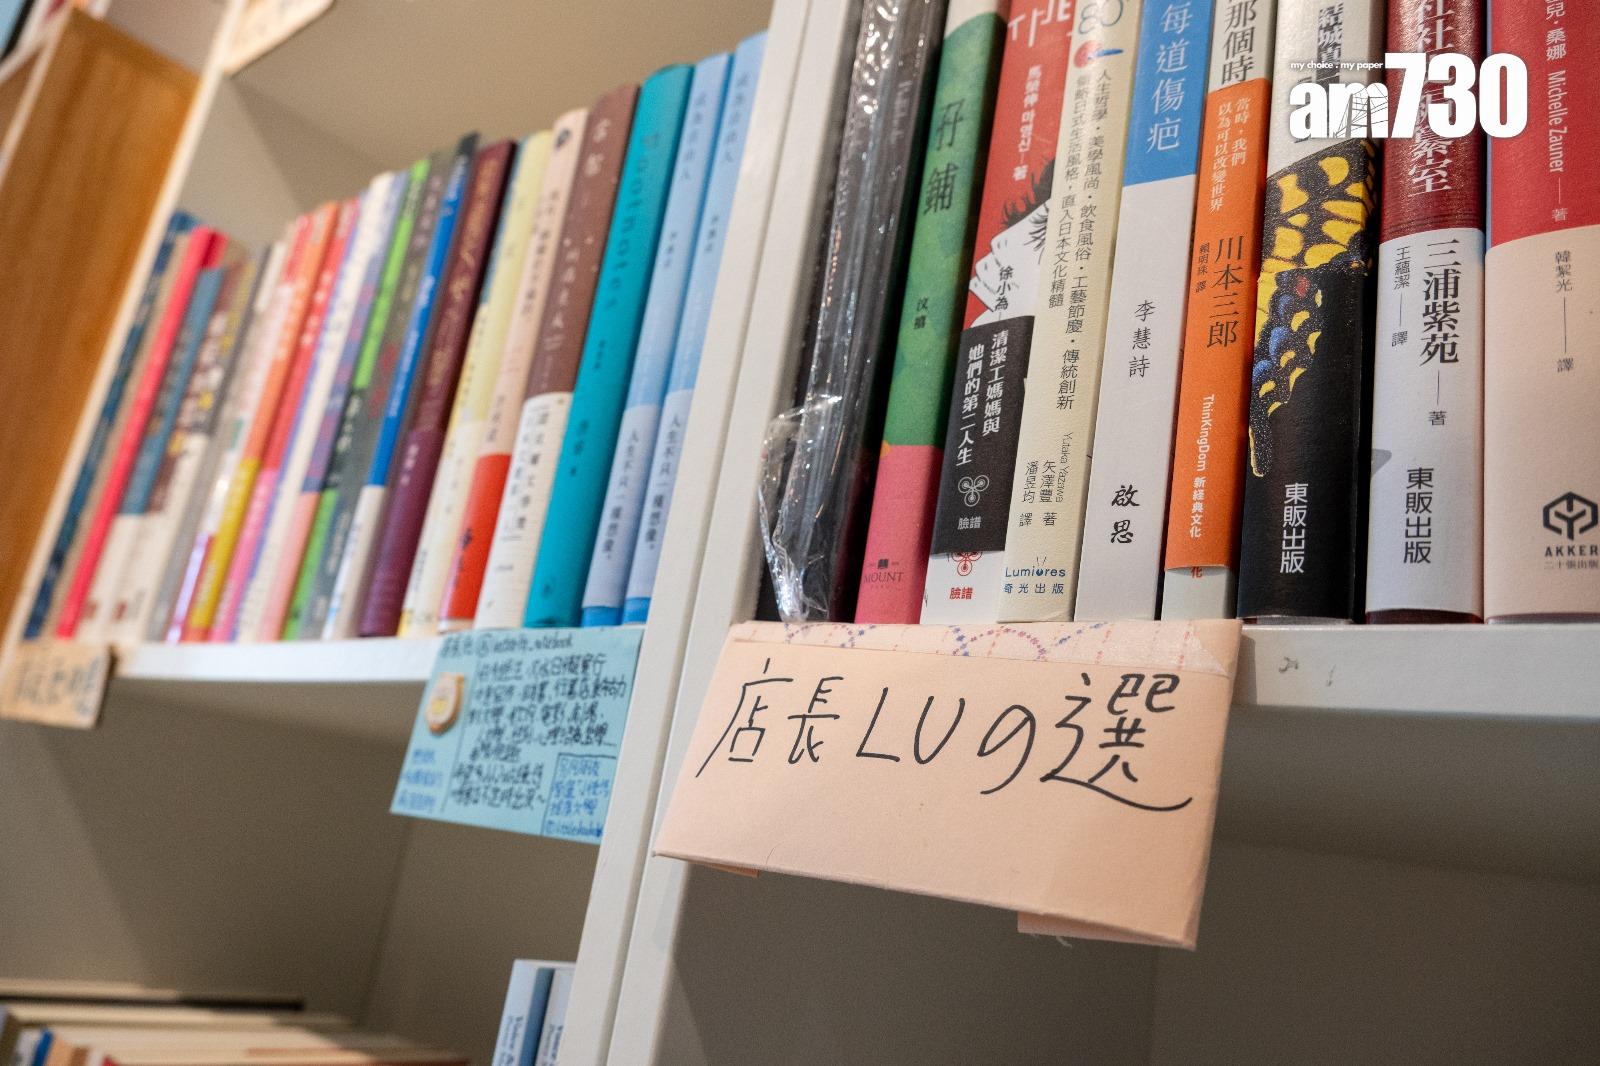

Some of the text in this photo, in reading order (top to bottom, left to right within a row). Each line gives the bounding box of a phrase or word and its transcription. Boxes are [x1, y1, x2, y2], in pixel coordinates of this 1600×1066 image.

[1147, 2, 1194, 153] 每道傷疤
[1548, 70, 1568, 125] Michelle
[1549, 127, 1568, 172] Zauner
[993, 265, 1014, 311] 徐小為
[1207, 235, 1244, 348] 川本三郎
[1128, 300, 1156, 378] 李慧詩
[1420, 239, 1462, 426] 三浦紫苑 著
[955, 343, 985, 467] 她們的第二人生
[982, 329, 1009, 437] 清潔工媽媽與
[1060, 432, 1073, 464] Yutaka
[957, 516, 982, 530] 臉譜
[1042, 512, 1058, 526] 著
[1279, 482, 1309, 574] 東販出版
[1404, 467, 1434, 564] 東販出版
[1544, 544, 1598, 557] AKKER
[949, 587, 973, 600] 臉譜
[1003, 582, 1064, 595] 奇光出版
